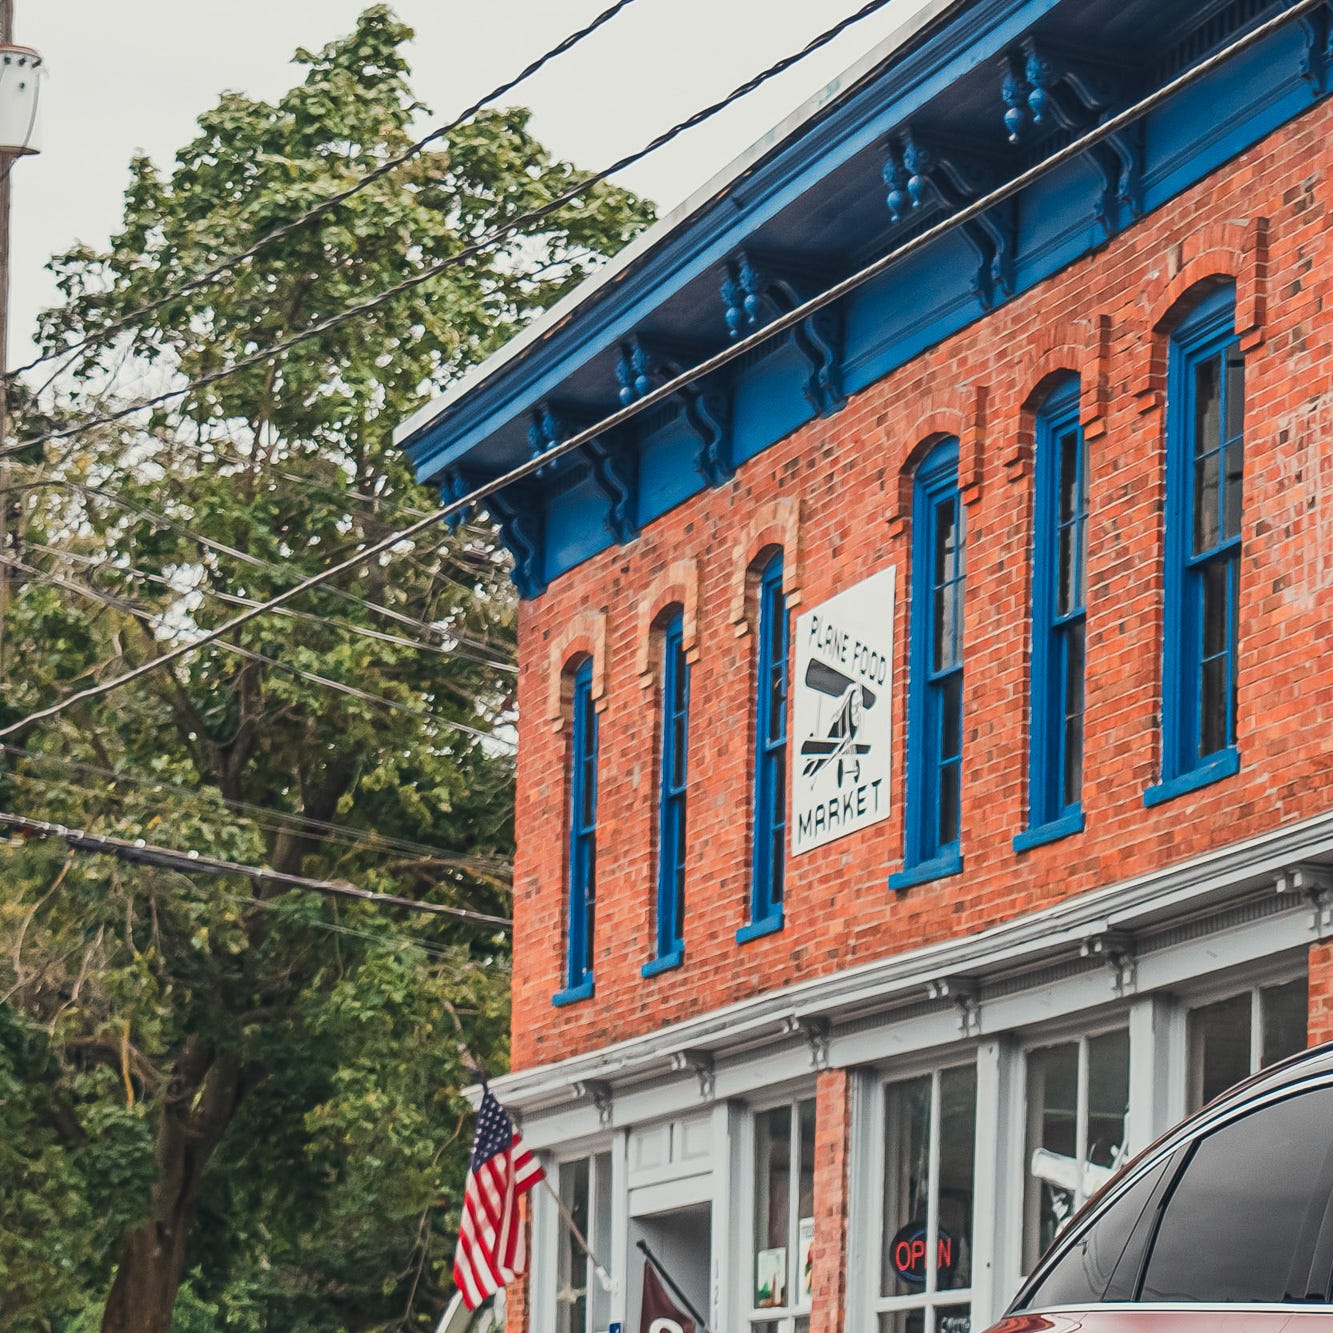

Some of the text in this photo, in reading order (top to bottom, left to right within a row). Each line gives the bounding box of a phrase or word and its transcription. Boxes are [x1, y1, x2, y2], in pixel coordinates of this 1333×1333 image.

[808, 615, 887, 685] PLANE FOOD
[798, 778, 882, 844] MARKET
[895, 1238, 952, 1271] OPN
